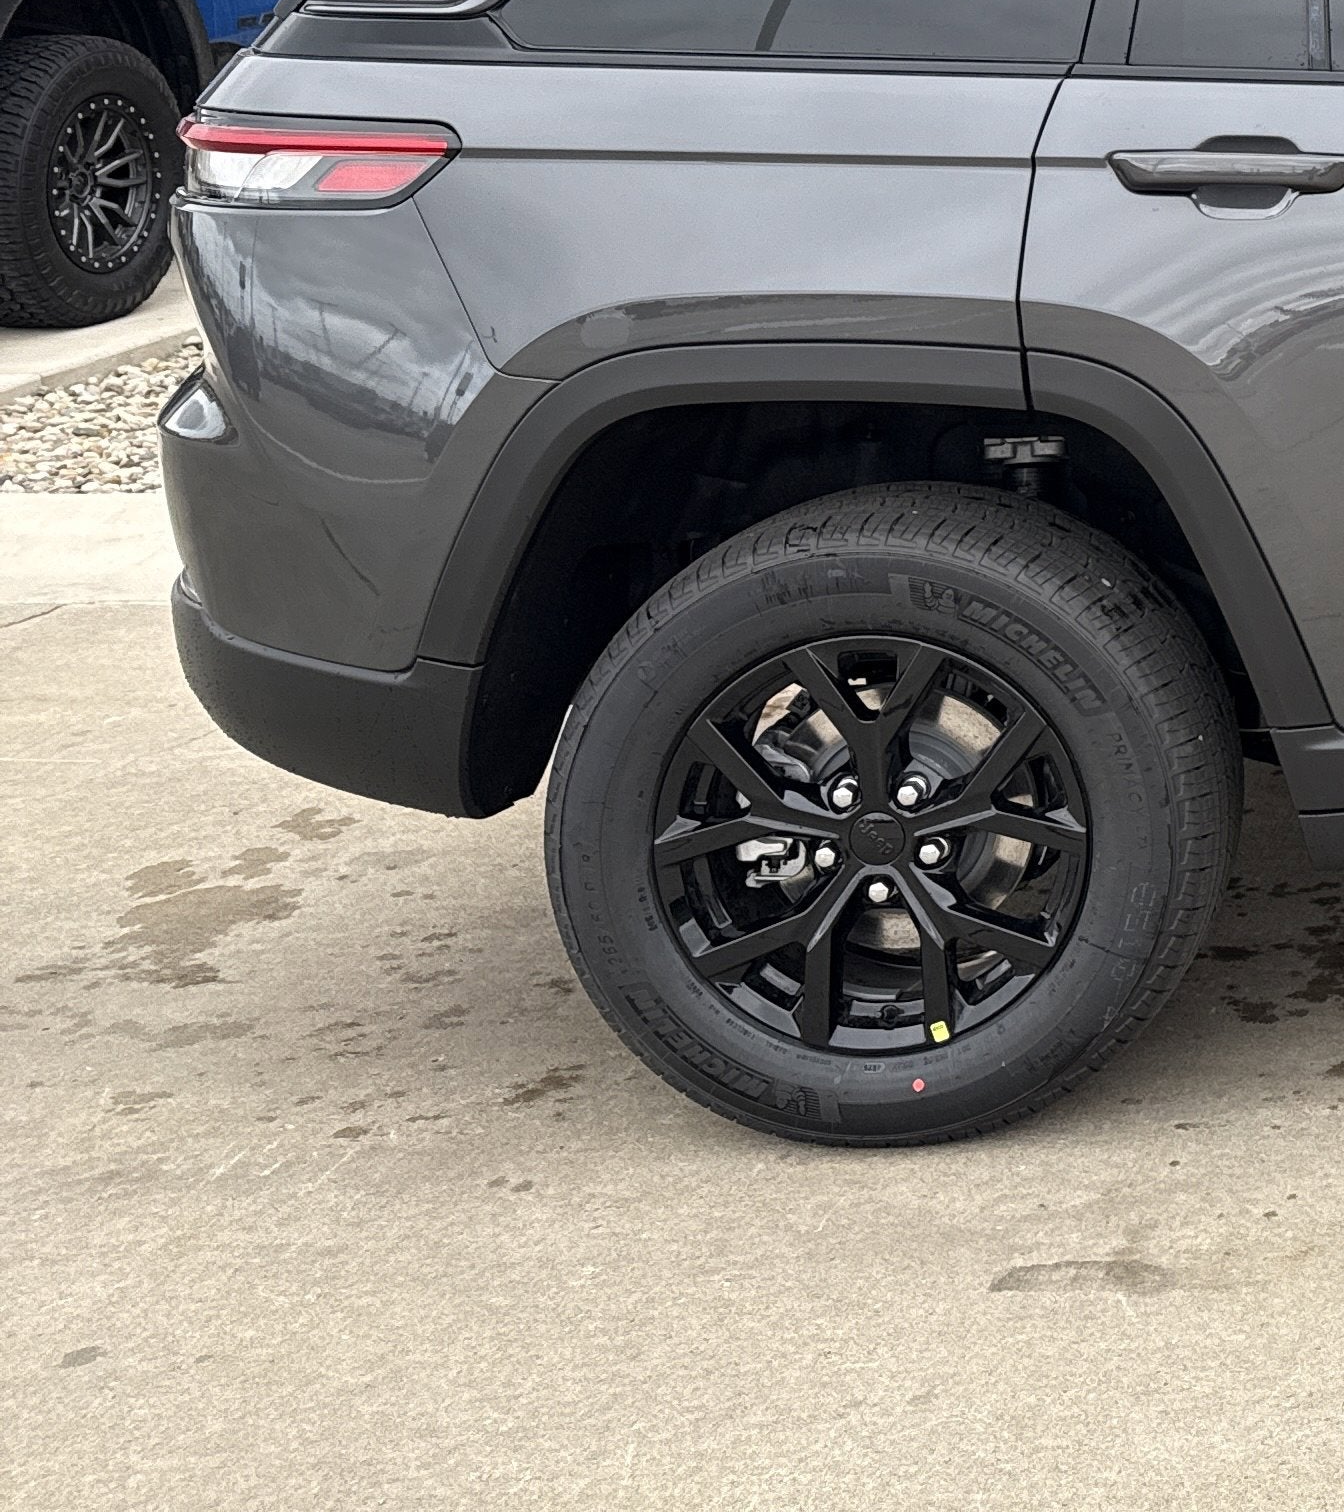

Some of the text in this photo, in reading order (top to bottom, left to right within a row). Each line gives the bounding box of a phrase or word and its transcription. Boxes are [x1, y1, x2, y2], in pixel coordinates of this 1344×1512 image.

[961, 600, 1102, 711] MICHELIN
[858, 822, 895, 855] Jeep
[627, 988, 770, 1101] MICHELIN
